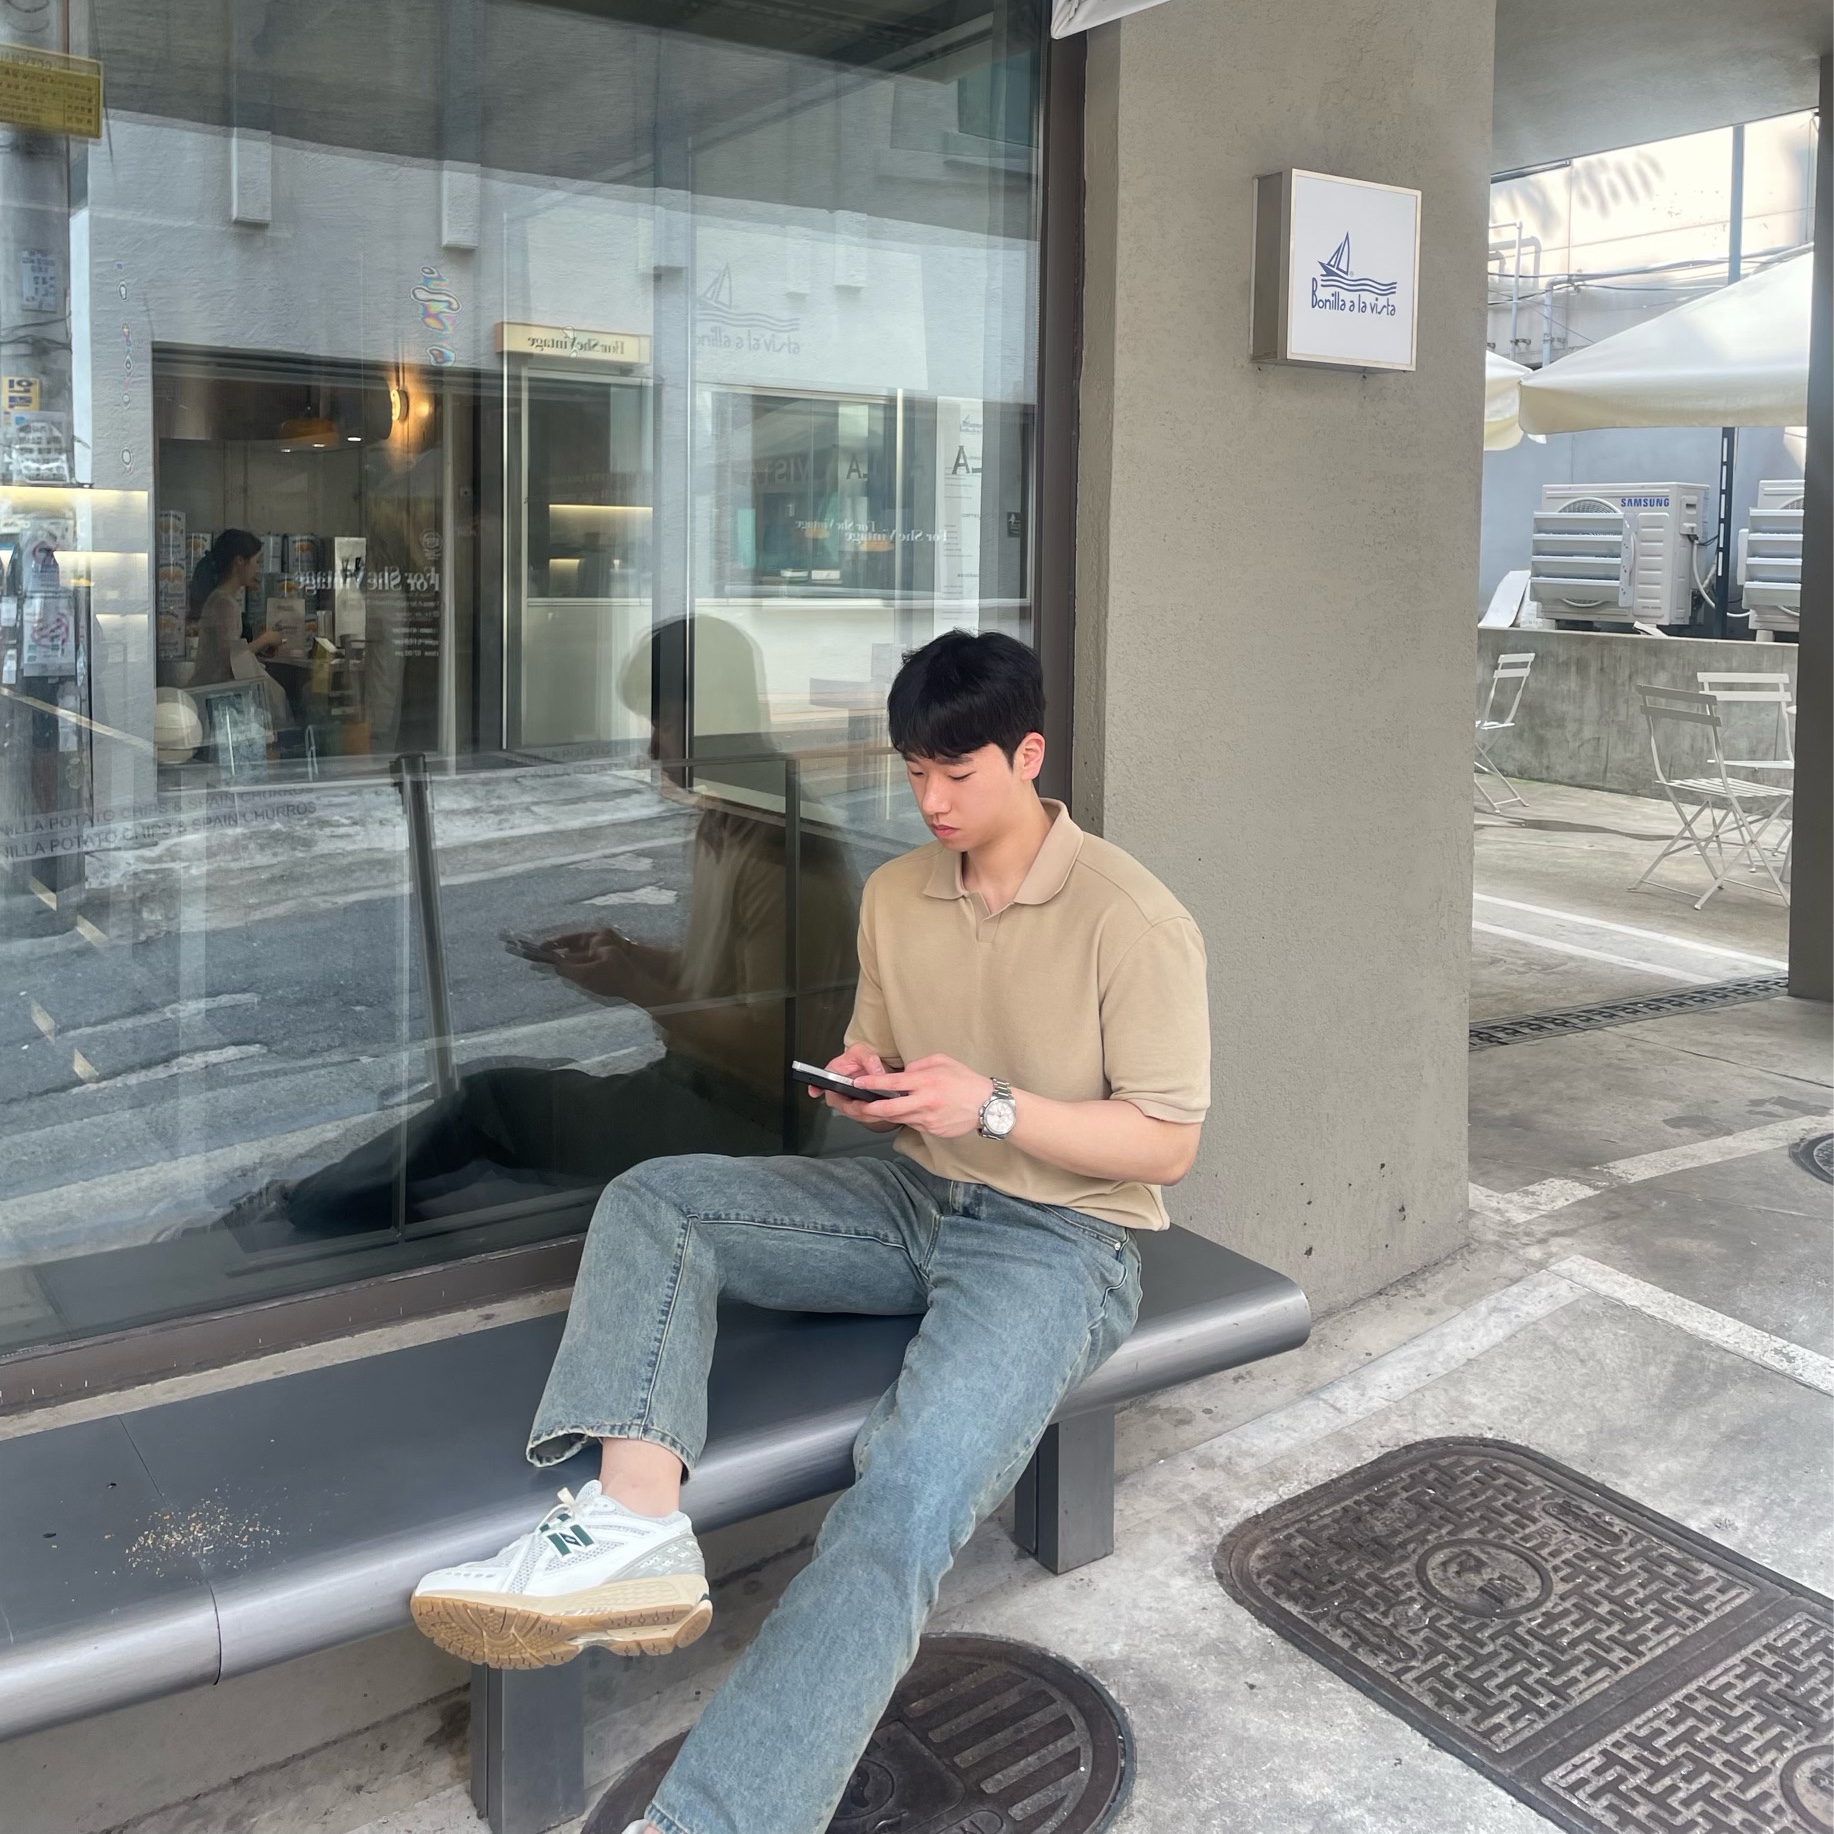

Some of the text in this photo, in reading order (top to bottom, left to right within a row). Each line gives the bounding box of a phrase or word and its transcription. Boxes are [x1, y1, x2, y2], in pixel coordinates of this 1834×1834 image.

[1311, 276, 1396, 317] Bonilla a la vista
[1620, 498, 1670, 508] SAMSUNG
[243, 801, 318, 823] CHURROS
